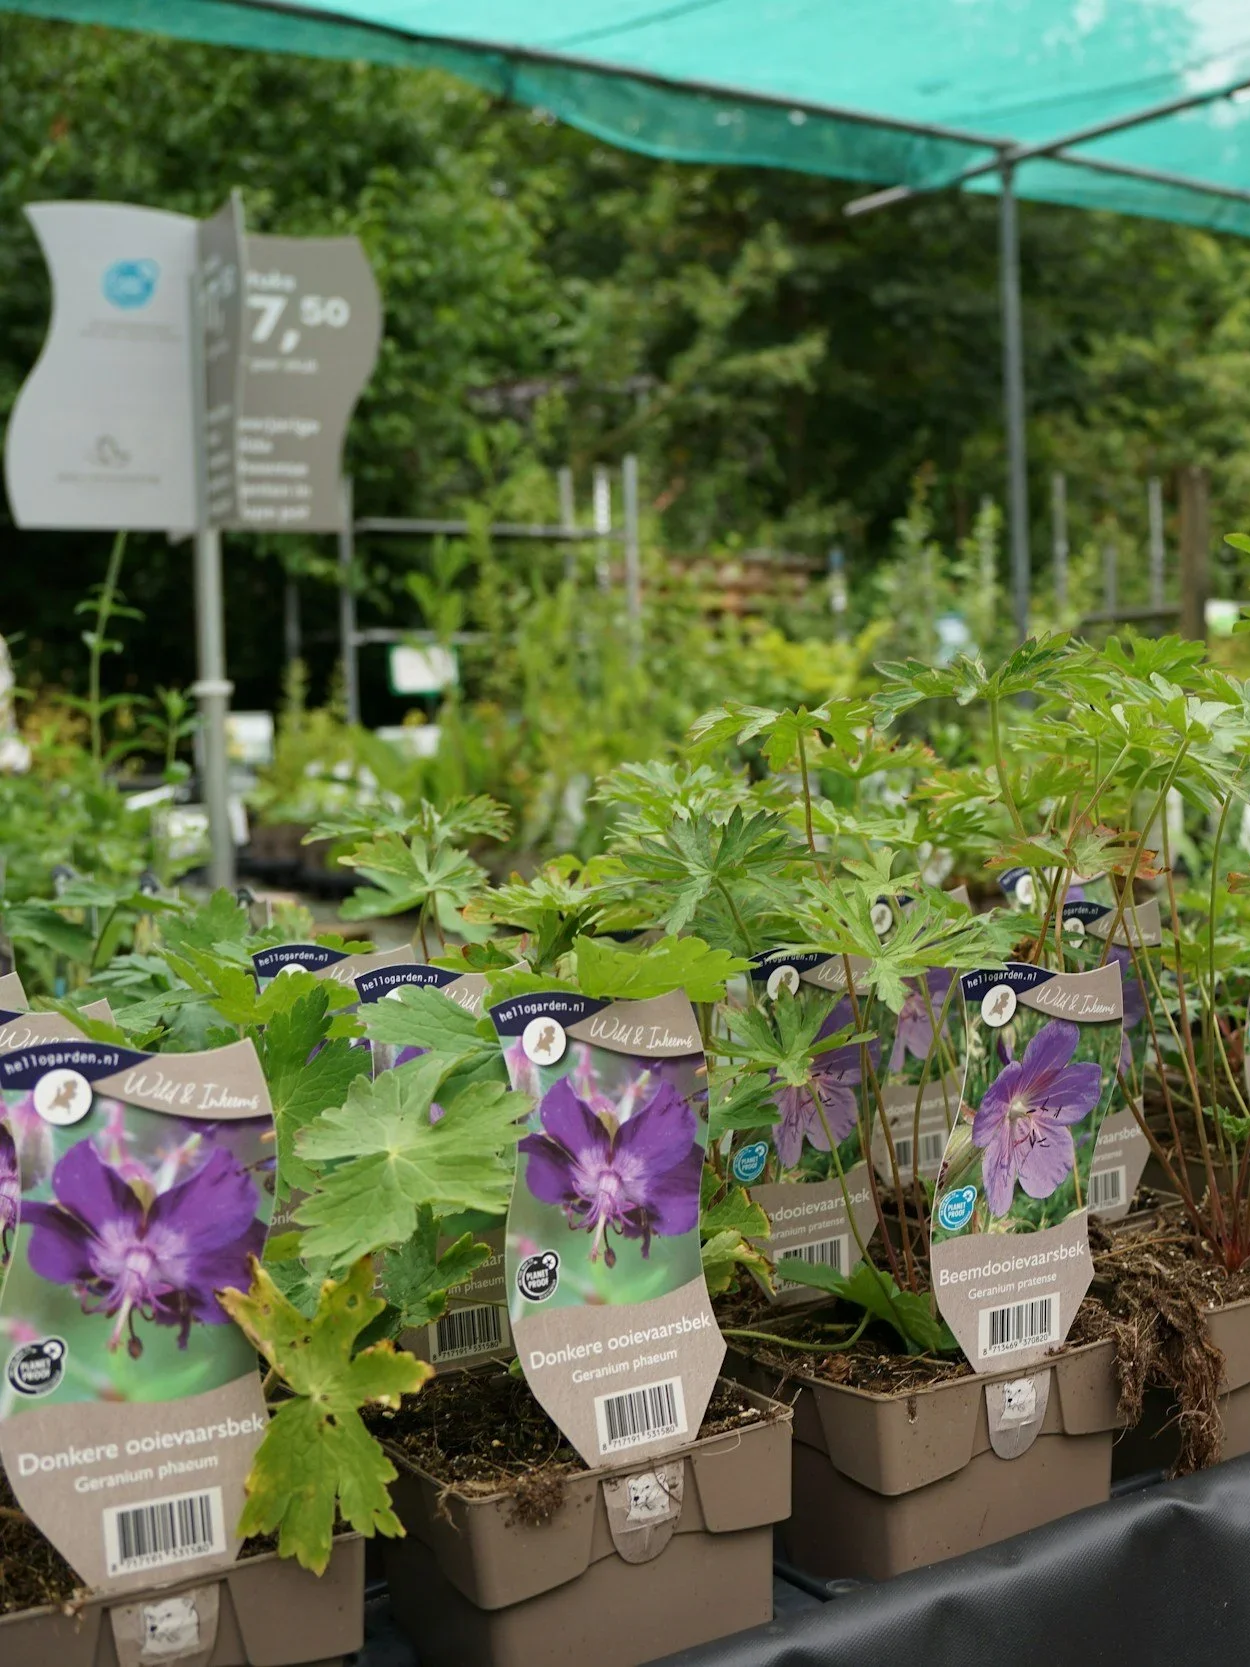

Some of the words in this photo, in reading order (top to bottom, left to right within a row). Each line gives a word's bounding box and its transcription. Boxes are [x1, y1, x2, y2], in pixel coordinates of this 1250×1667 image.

[1063, 906, 1099, 916] ogarden.nl
[258, 951, 328, 967] hellogarden.nl
[361, 973, 439, 992] hellogarden.nl
[966, 970, 1037, 988] hellogarden.nl
[498, 1000, 586, 1023] hellogarden.nl
[1036, 986, 1067, 1011] Wild
[1068, 993, 1080, 1012] &
[1078, 994, 1115, 1015] Inheems
[590, 1016, 633, 1046] Wild
[632, 1025, 644, 1048] &
[646, 1026, 695, 1050] Inheems
[4, 1051, 119, 1076] hellogarden.nl
[123, 1071, 181, 1104] Wild
[180, 1082, 197, 1104] &
[197, 1083, 260, 1110] Inheems
[947, 1201, 966, 1212] PLANET
[948, 1209, 966, 1218] PROOF
[771, 1227, 806, 1241] eranium
[808, 1216, 846, 1234] pratense
[526, 1268, 549, 1281] PLANET
[939, 1241, 1085, 1287] Beemdooievaarsbek
[464, 1275, 505, 1295] phaeum
[528, 1277, 549, 1289] PROOF
[968, 1281, 1015, 1300] Geranium
[1017, 1272, 1057, 1291] pratense
[529, 1340, 603, 1370] Donkere
[607, 1312, 712, 1350] ooievaarsbek
[572, 1362, 630, 1384] Geranium
[632, 1349, 678, 1373] phaeum
[18, 1443, 119, 1477] Donkere
[125, 1412, 265, 1456] ooievaarsbek
[74, 1466, 155, 1493] Geranium
[158, 1454, 219, 1480] phaeum
